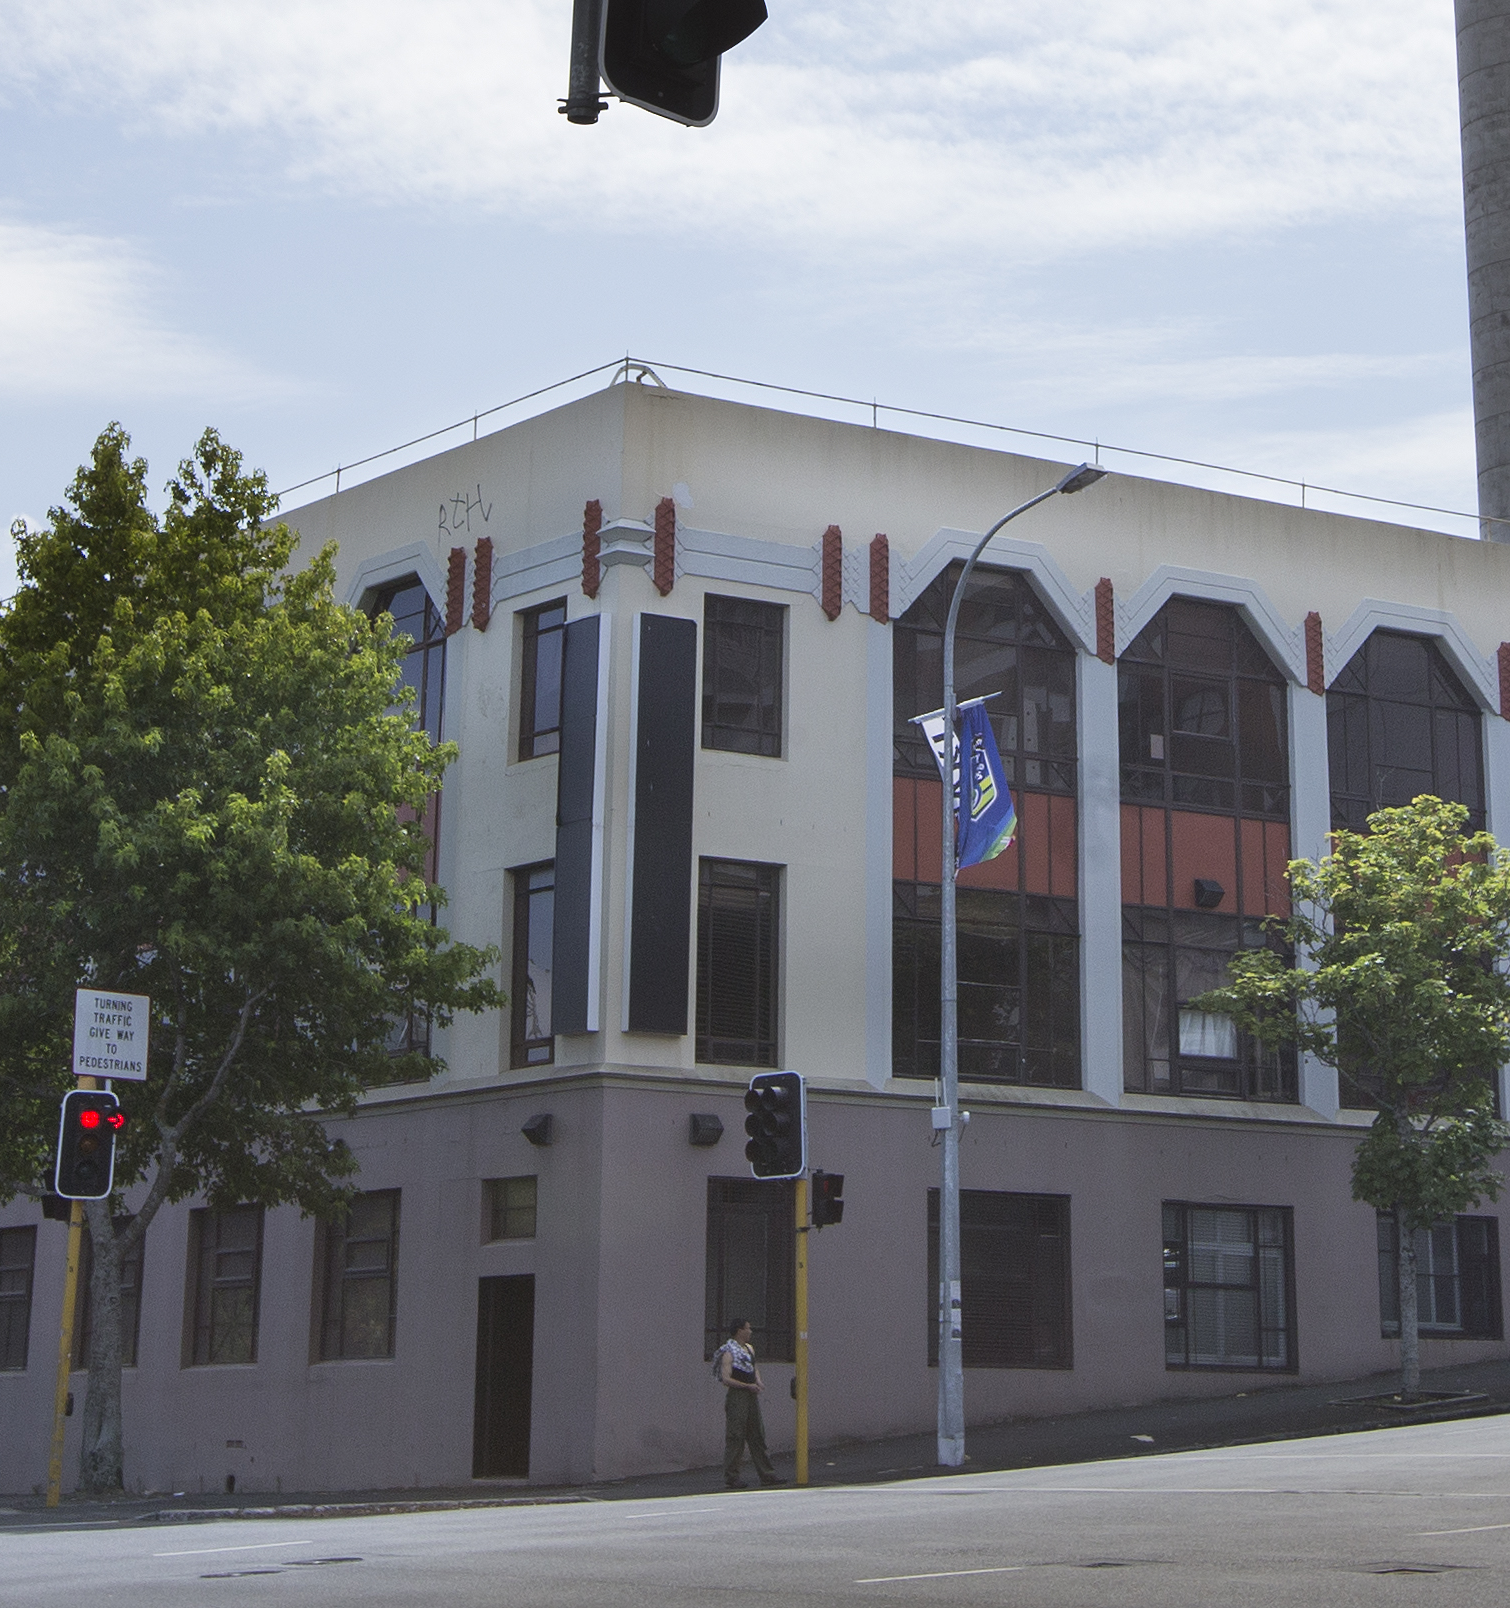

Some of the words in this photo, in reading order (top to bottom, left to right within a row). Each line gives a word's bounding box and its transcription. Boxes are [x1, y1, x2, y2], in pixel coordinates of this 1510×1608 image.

[94, 997, 133, 1012] TURNING
[93, 1012, 132, 1027] TRAFFIC
[89, 1027, 111, 1039] GIVE
[117, 1029, 135, 1041] WAY
[106, 1043, 118, 1055] TO
[79, 1056, 142, 1072] PEDESTRIANS
